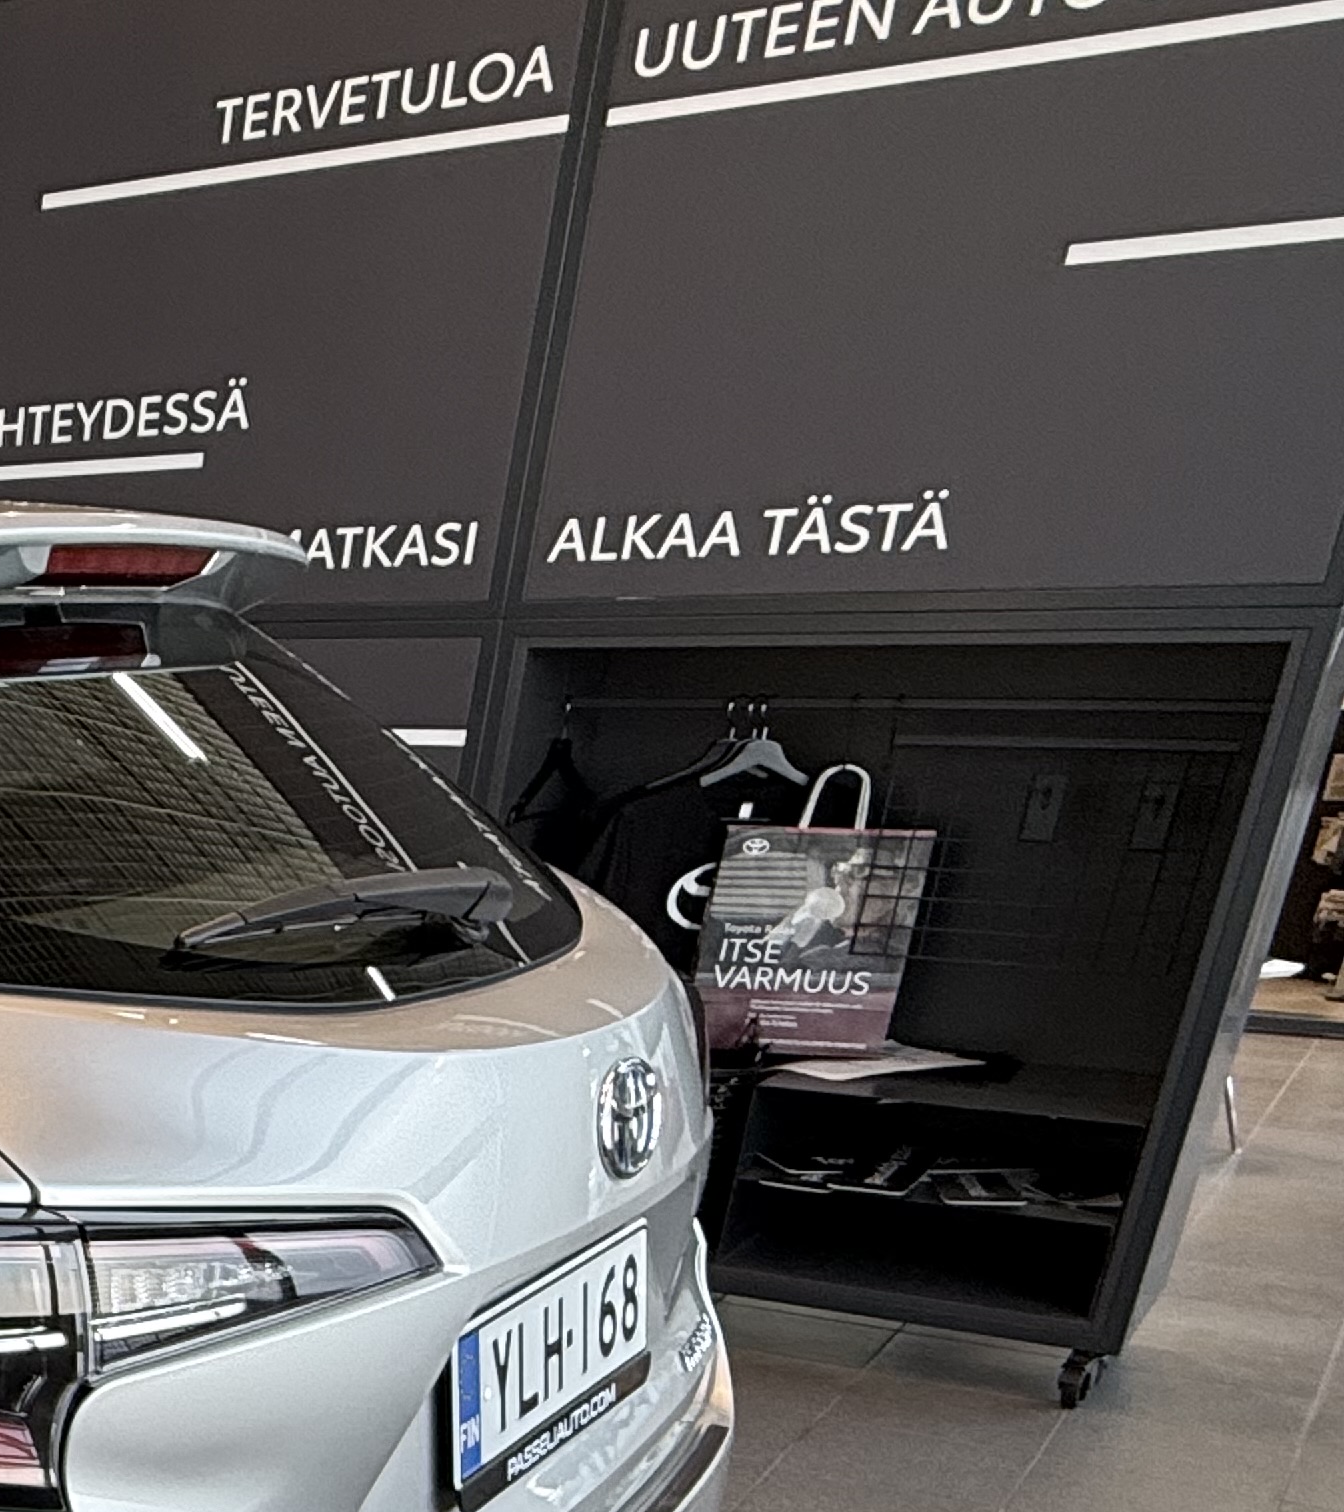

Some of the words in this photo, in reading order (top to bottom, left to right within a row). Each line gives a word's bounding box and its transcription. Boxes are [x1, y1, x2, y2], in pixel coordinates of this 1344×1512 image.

[216, 44, 554, 144] TERVETULOA
[634, 0, 896, 78] UUTEEN
[289, 520, 479, 570] ATKASI
[546, 510, 741, 564] ALKAA
[762, 488, 950, 556] TÄSTÄ
[714, 964, 872, 996] VARMUUS
[719, 938, 783, 964] ITSE
[492, 1253, 638, 1433] YLH-168
[460, 1413, 480, 1454] FIN
